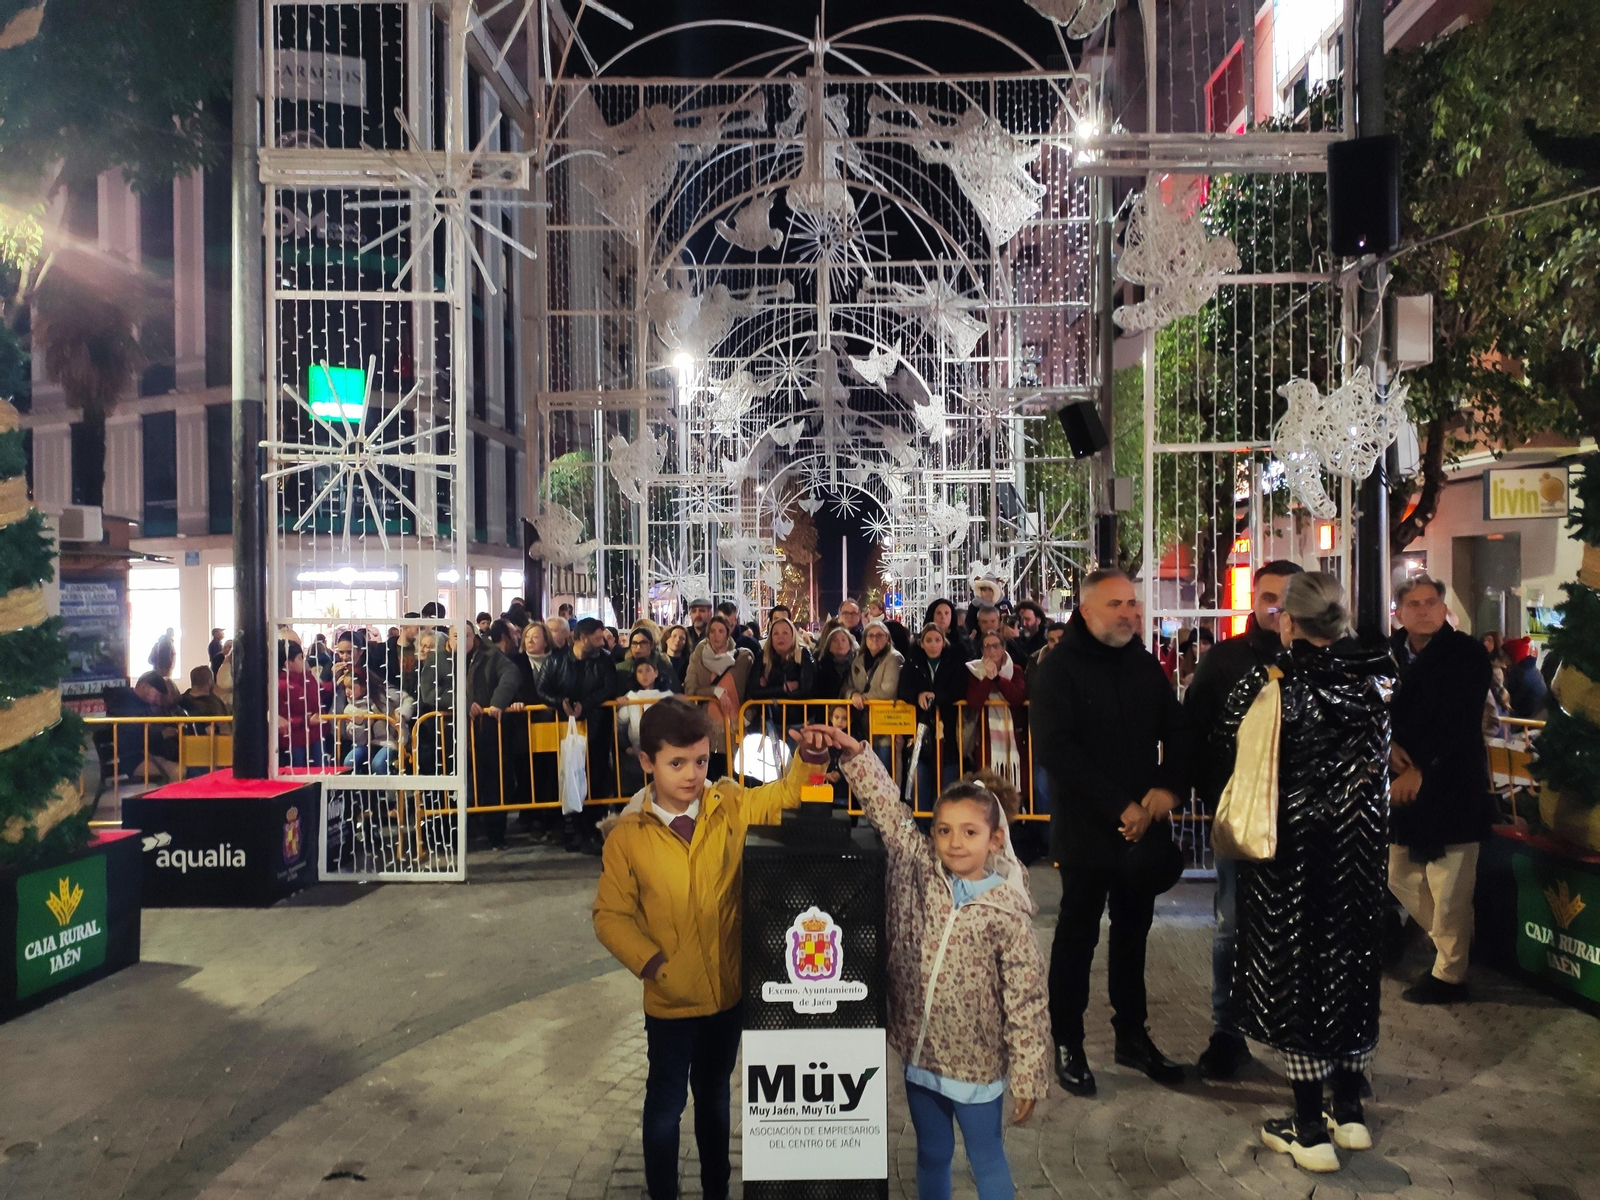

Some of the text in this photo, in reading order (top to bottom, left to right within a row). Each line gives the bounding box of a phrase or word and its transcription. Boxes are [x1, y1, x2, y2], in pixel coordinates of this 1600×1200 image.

[156, 843, 246, 874] aqualia
[25, 920, 101, 960] CAJA RURAL
[1525, 921, 1555, 947] CAJA
[50, 947, 81, 975] JAÉN
[768, 986, 863, 996] Excmo. Ayuntamiento
[799, 998, 832, 1007] de Jaén
[748, 1062, 880, 1112] Müy
[749, 1104, 836, 1117] Muy Jaén, Muy Tú
[749, 1125, 880, 1136] ASOCIACIÓN DE EMPRESARIOS
[769, 1137, 861, 1149] DEL CENTRO DE JAÉN
